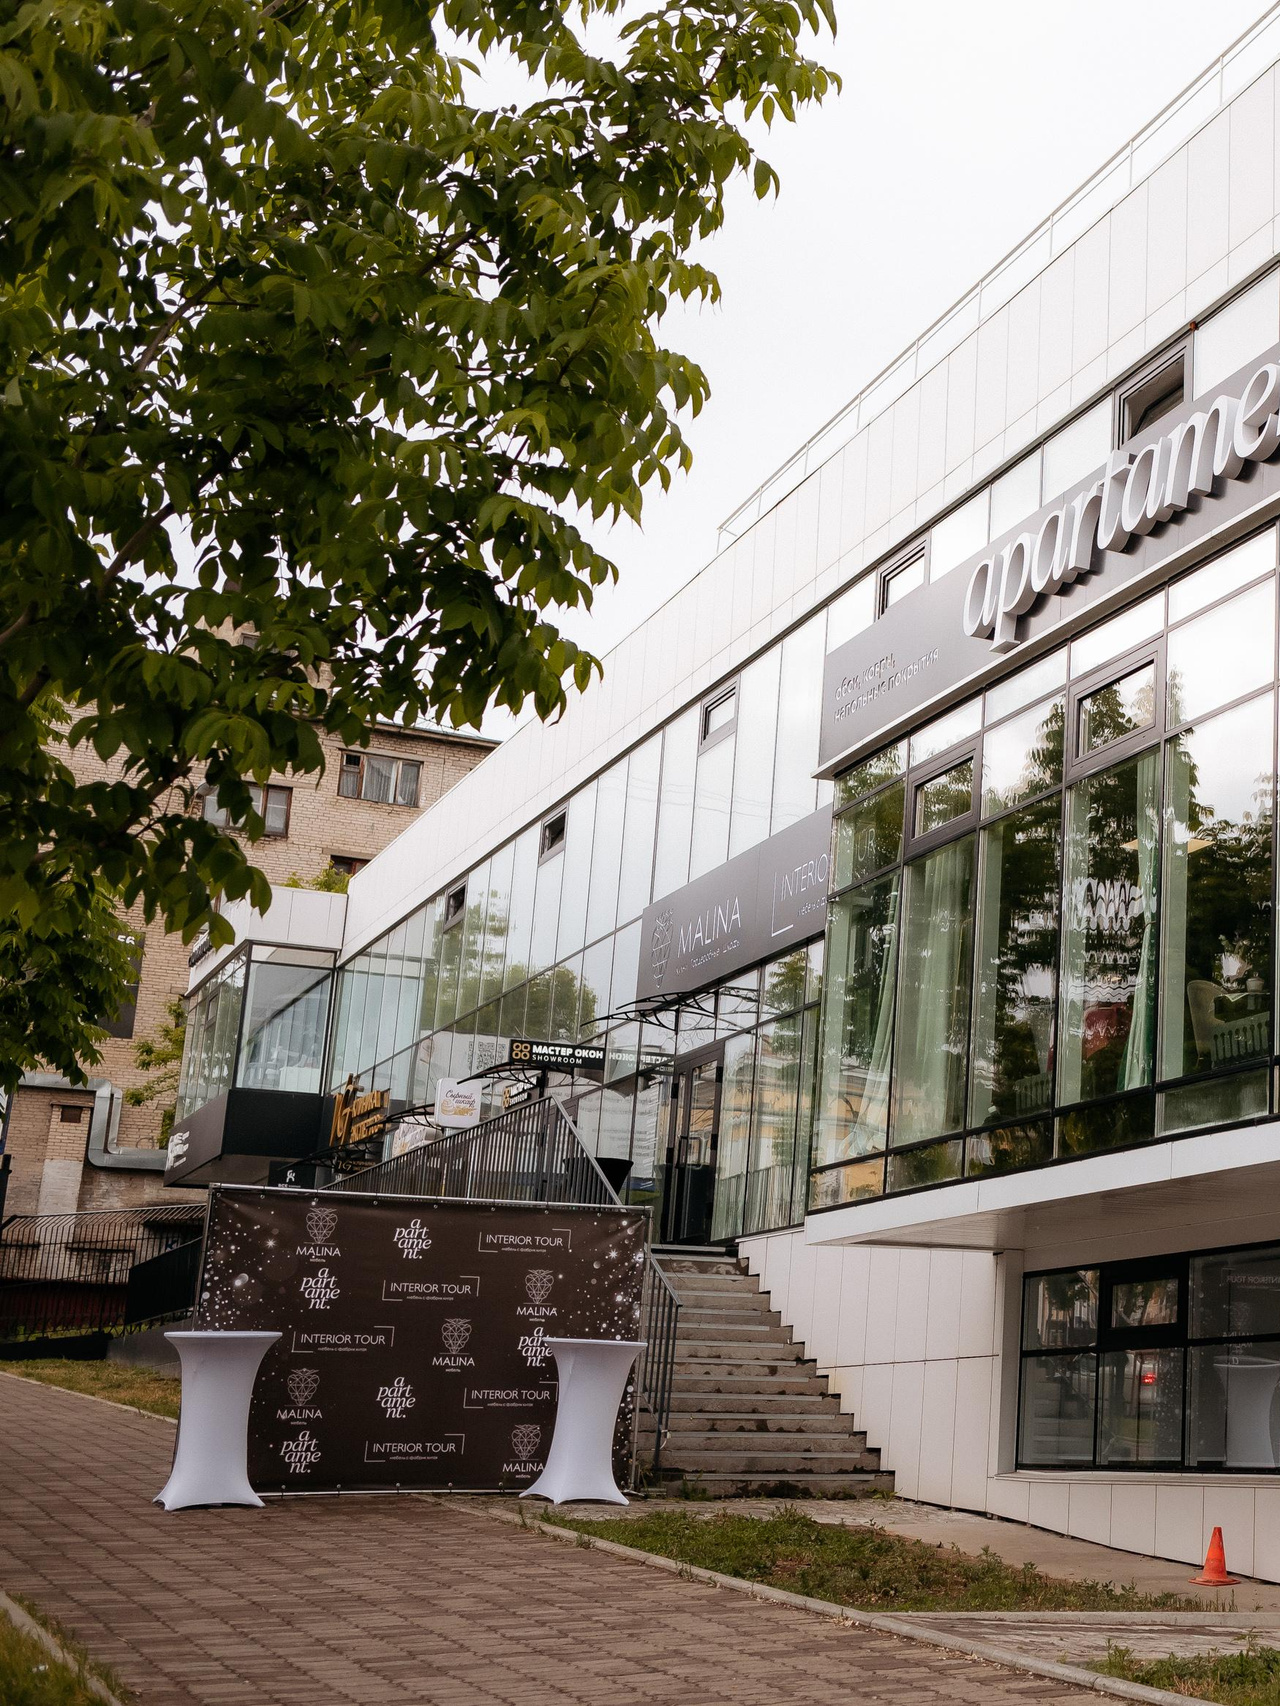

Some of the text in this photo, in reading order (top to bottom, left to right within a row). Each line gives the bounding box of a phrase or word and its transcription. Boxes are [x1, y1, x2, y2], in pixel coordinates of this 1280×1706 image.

[833, 647, 939, 724] напольные покрытия
[781, 853, 829, 902] INTERIO
[677, 896, 741, 958] MALINA
[532, 1044, 604, 1060] МАСТЕР ОКОН
[532, 1054, 583, 1065] SHOWROOM
[410, 1218, 421, 1228] a
[393, 1227, 429, 1242] part
[398, 1238, 432, 1249] ame
[486, 1234, 563, 1247] INTERIOR TOUR
[296, 1246, 341, 1257] MALINA
[317, 1267, 329, 1278] a
[300, 1276, 338, 1291] part
[390, 1282, 471, 1294] INTERIOR TOUR
[305, 1287, 340, 1299] ame
[516, 1306, 558, 1316] MALINA
[533, 1326, 544, 1337] a
[301, 1333, 386, 1345] INTERIOR TOUR
[432, 1356, 475, 1367] MALINA
[394, 1376, 405, 1387] a
[376, 1384, 413, 1401] part
[471, 1390, 550, 1400] INTERIOR TOUR
[381, 1397, 416, 1408] ame
[276, 1409, 323, 1419] MALINA
[298, 1430, 310, 1441] a
[279, 1439, 319, 1456] part
[373, 1442, 456, 1453] INTERIOR TOUR
[285, 1451, 321, 1463] ame
[502, 1462, 544, 1472] MALINA
